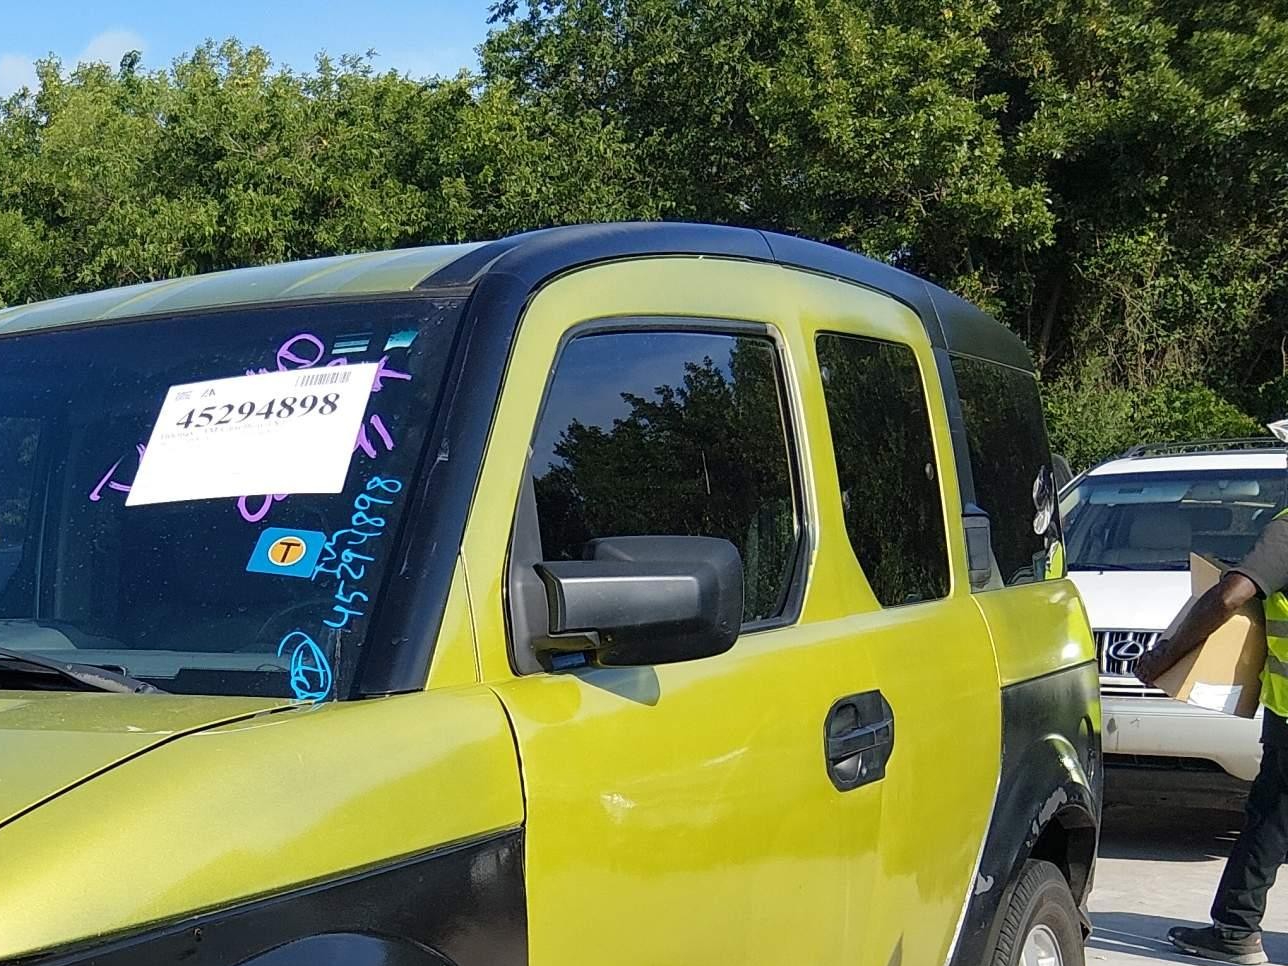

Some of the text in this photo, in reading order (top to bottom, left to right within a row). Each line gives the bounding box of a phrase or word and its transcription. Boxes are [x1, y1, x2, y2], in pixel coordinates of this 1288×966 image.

[176, 392, 341, 430] 45294898
[279, 541, 301, 563] T
[323, 476, 402, 628] 45294898
